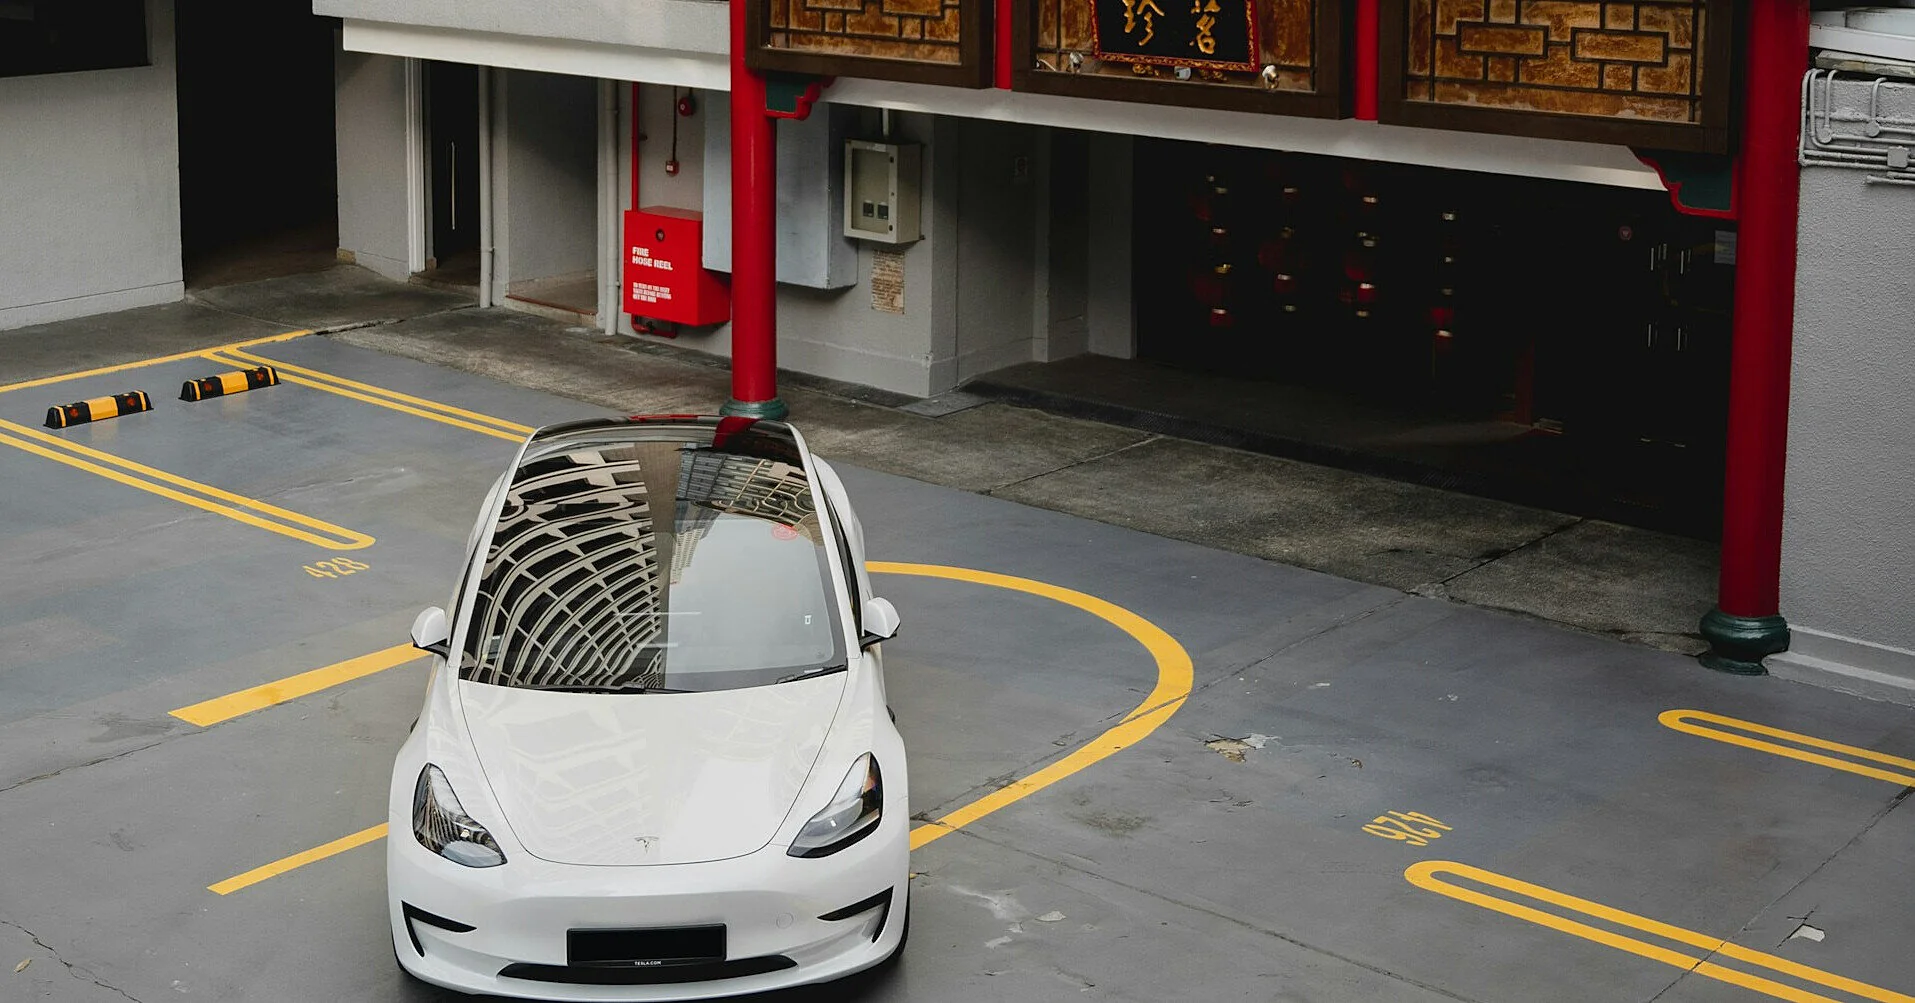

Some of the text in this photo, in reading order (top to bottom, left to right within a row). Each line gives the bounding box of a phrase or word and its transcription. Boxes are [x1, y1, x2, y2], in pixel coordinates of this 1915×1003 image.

[632, 246, 649, 257] FIRE
[632, 255, 673, 271] HOSE REEL
[1361, 810, 1453, 846] 426
